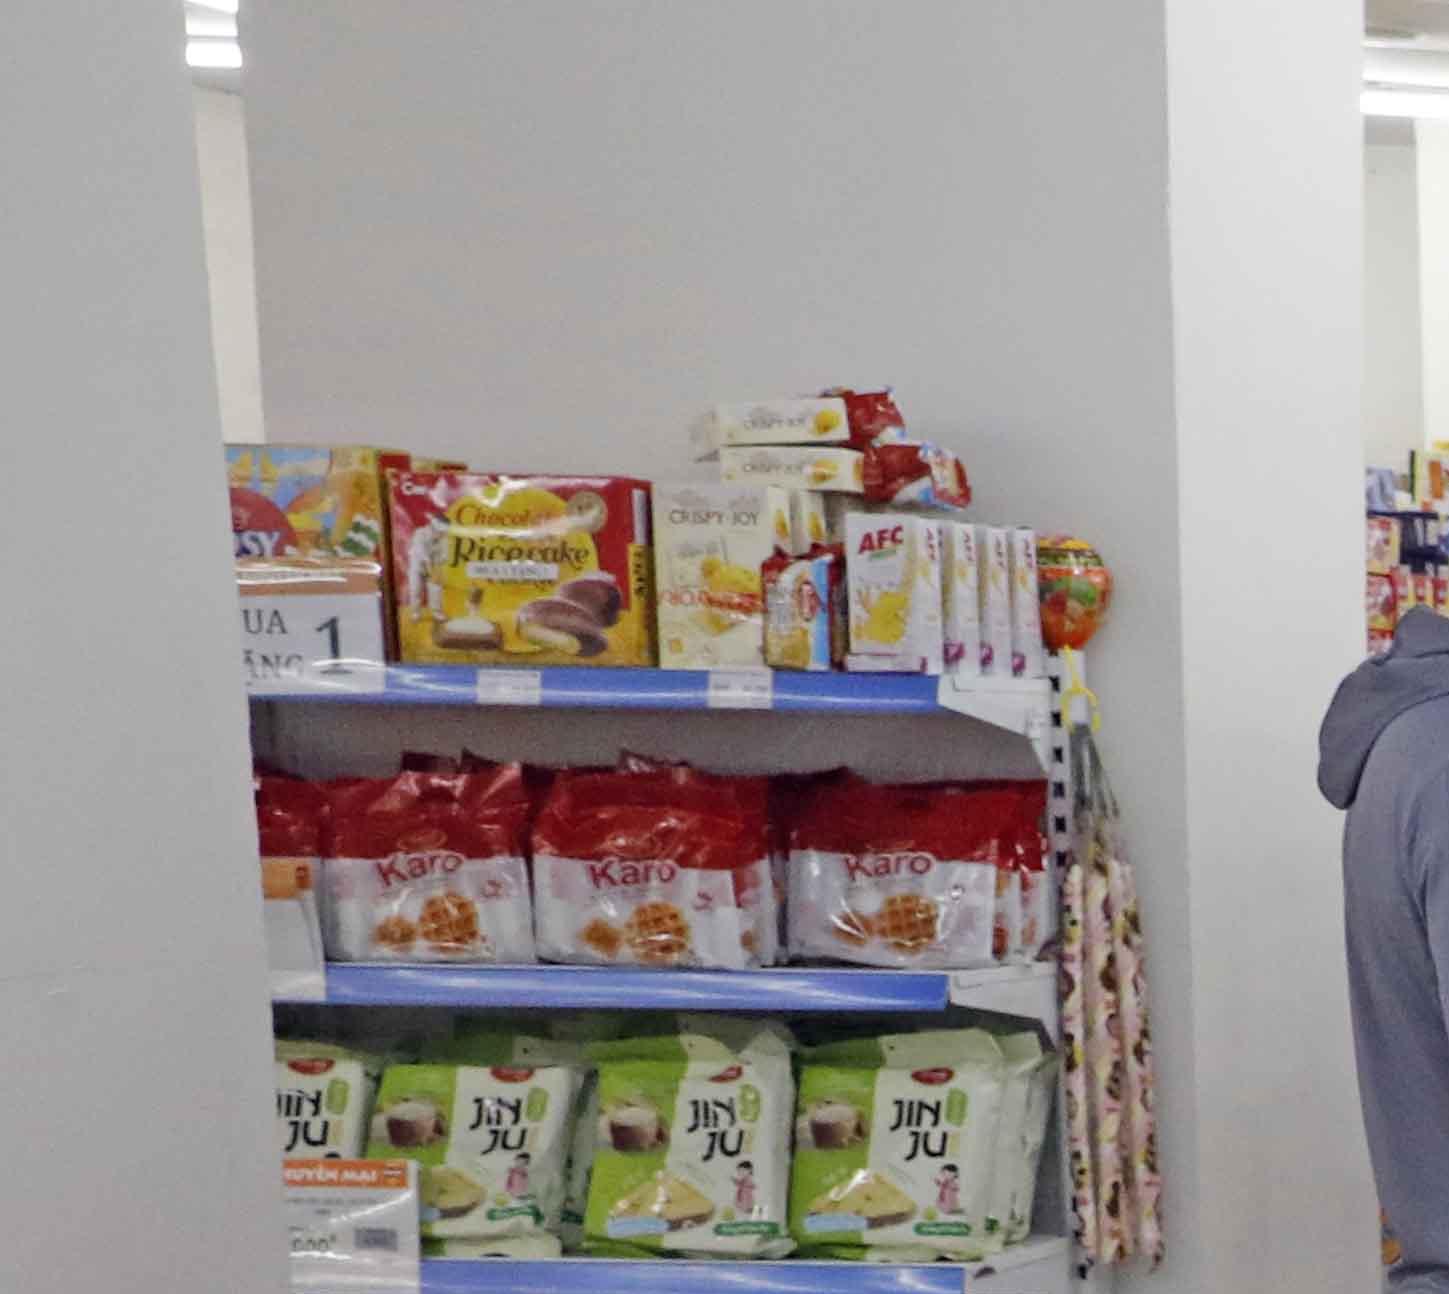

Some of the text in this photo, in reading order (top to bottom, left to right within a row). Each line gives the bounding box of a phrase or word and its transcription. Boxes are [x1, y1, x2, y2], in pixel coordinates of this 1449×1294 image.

[857, 525, 905, 555] AFC
[376, 849, 463, 888] Karo
[587, 858, 678, 888] Karo
[844, 851, 932, 881] Karo
[687, 1097, 737, 1133] JIN
[890, 1098, 942, 1132] JIN
[482, 1127, 527, 1155] JU
[702, 1129, 744, 1162] JU
[904, 1131, 949, 1162] JU
